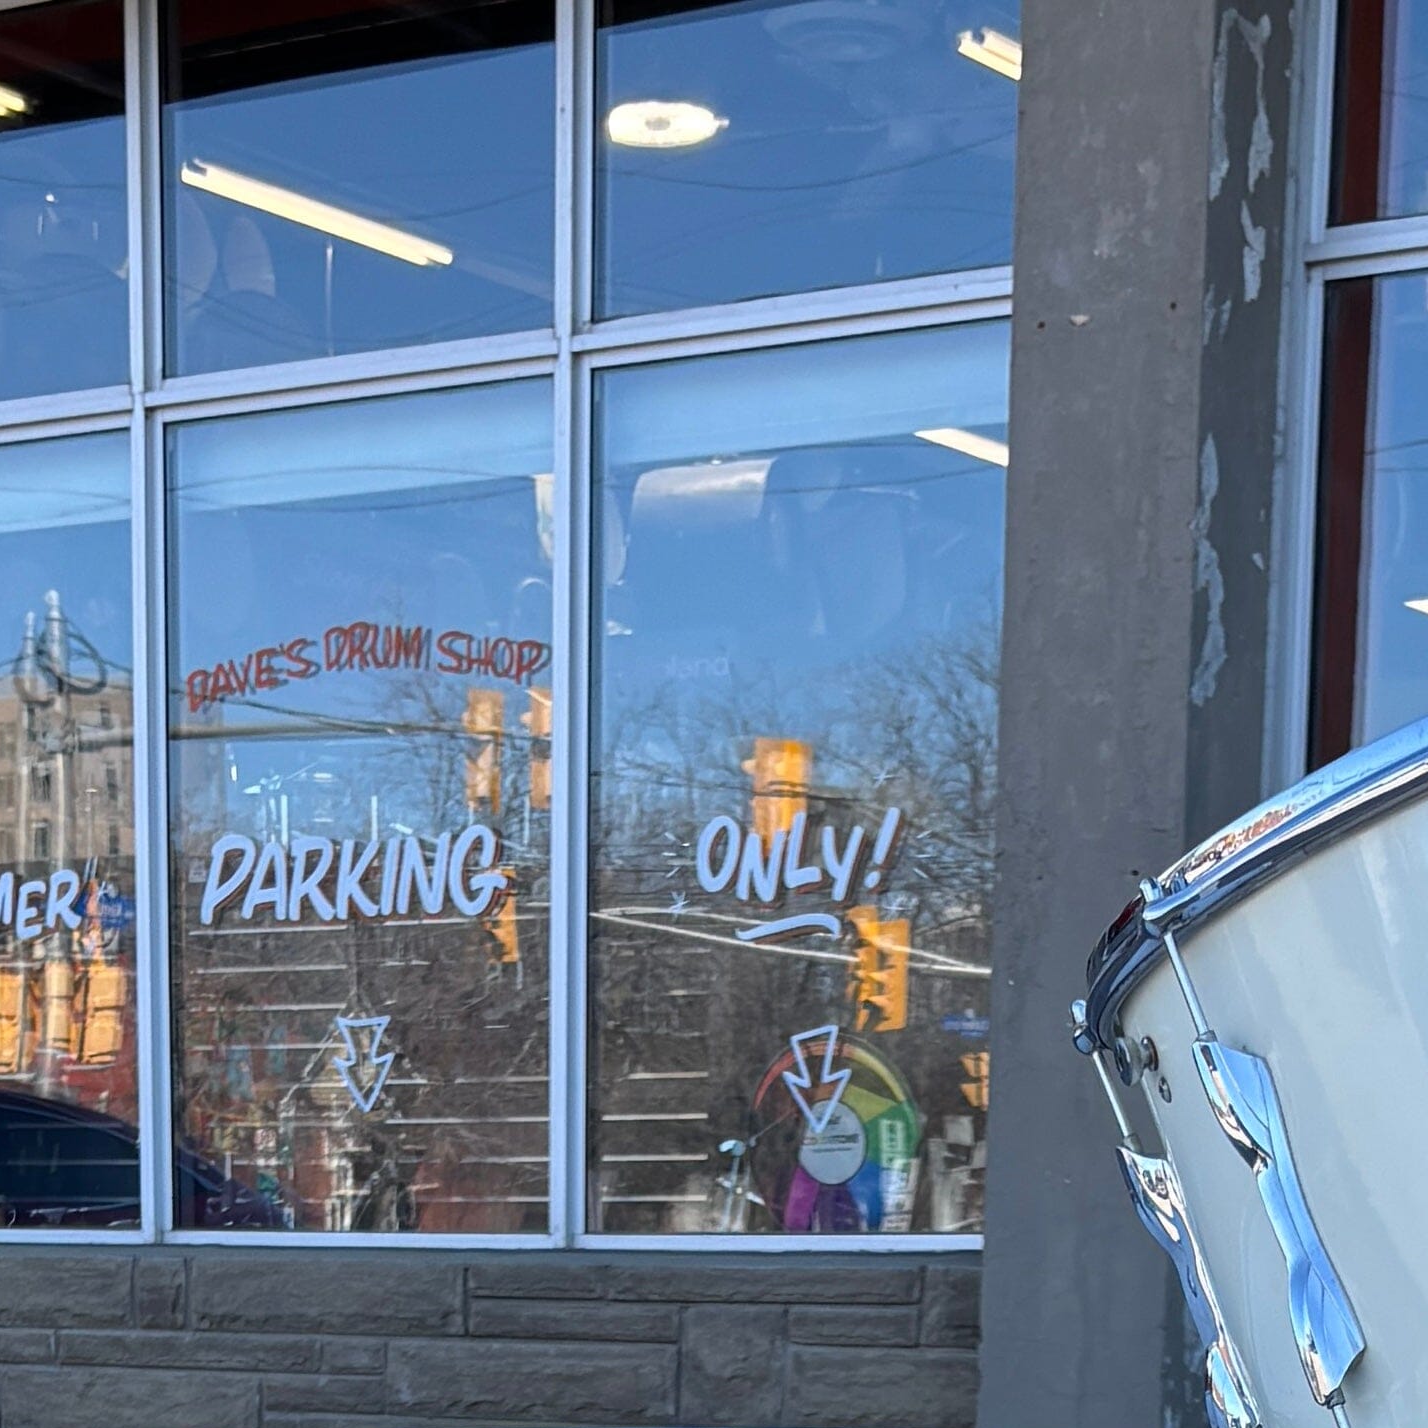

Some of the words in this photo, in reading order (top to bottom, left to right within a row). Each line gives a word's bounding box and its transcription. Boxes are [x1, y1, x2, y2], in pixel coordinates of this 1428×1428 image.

[186, 638, 312, 713] DAVE'S
[324, 621, 426, 674] DRUM
[436, 631, 546, 685] SHOP
[200, 824, 508, 926] PARKING
[695, 806, 901, 902] ONLY!
